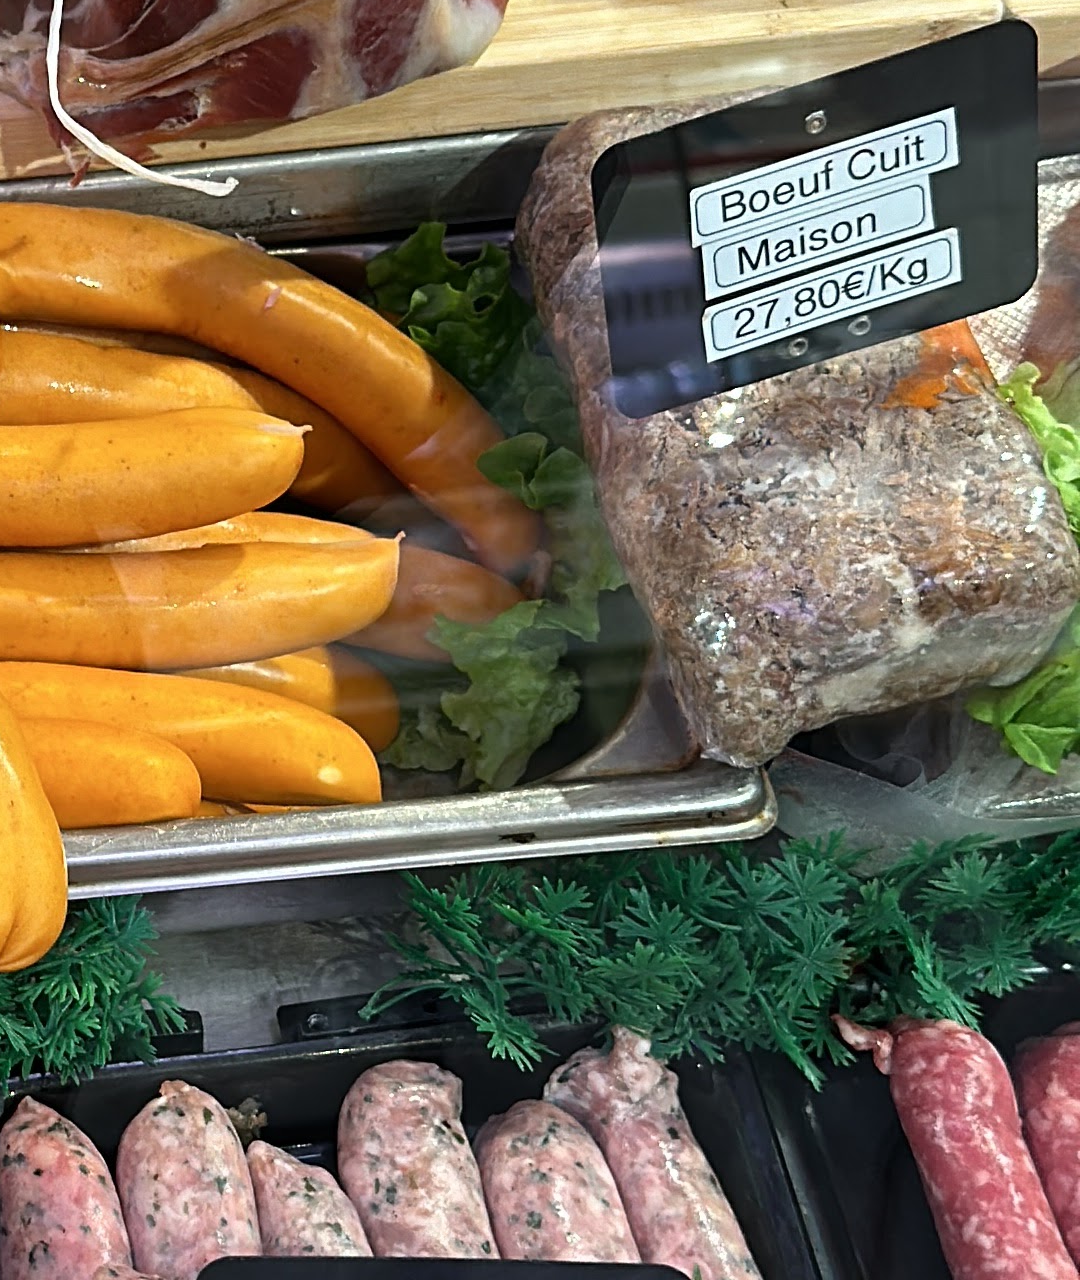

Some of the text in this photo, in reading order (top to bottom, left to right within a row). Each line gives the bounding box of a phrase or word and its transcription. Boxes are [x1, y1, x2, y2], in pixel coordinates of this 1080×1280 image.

[720, 134, 926, 223] Boeuf Cuit
[737, 211, 877, 276] Maison
[733, 256, 928, 340] 27,80€/Kg
